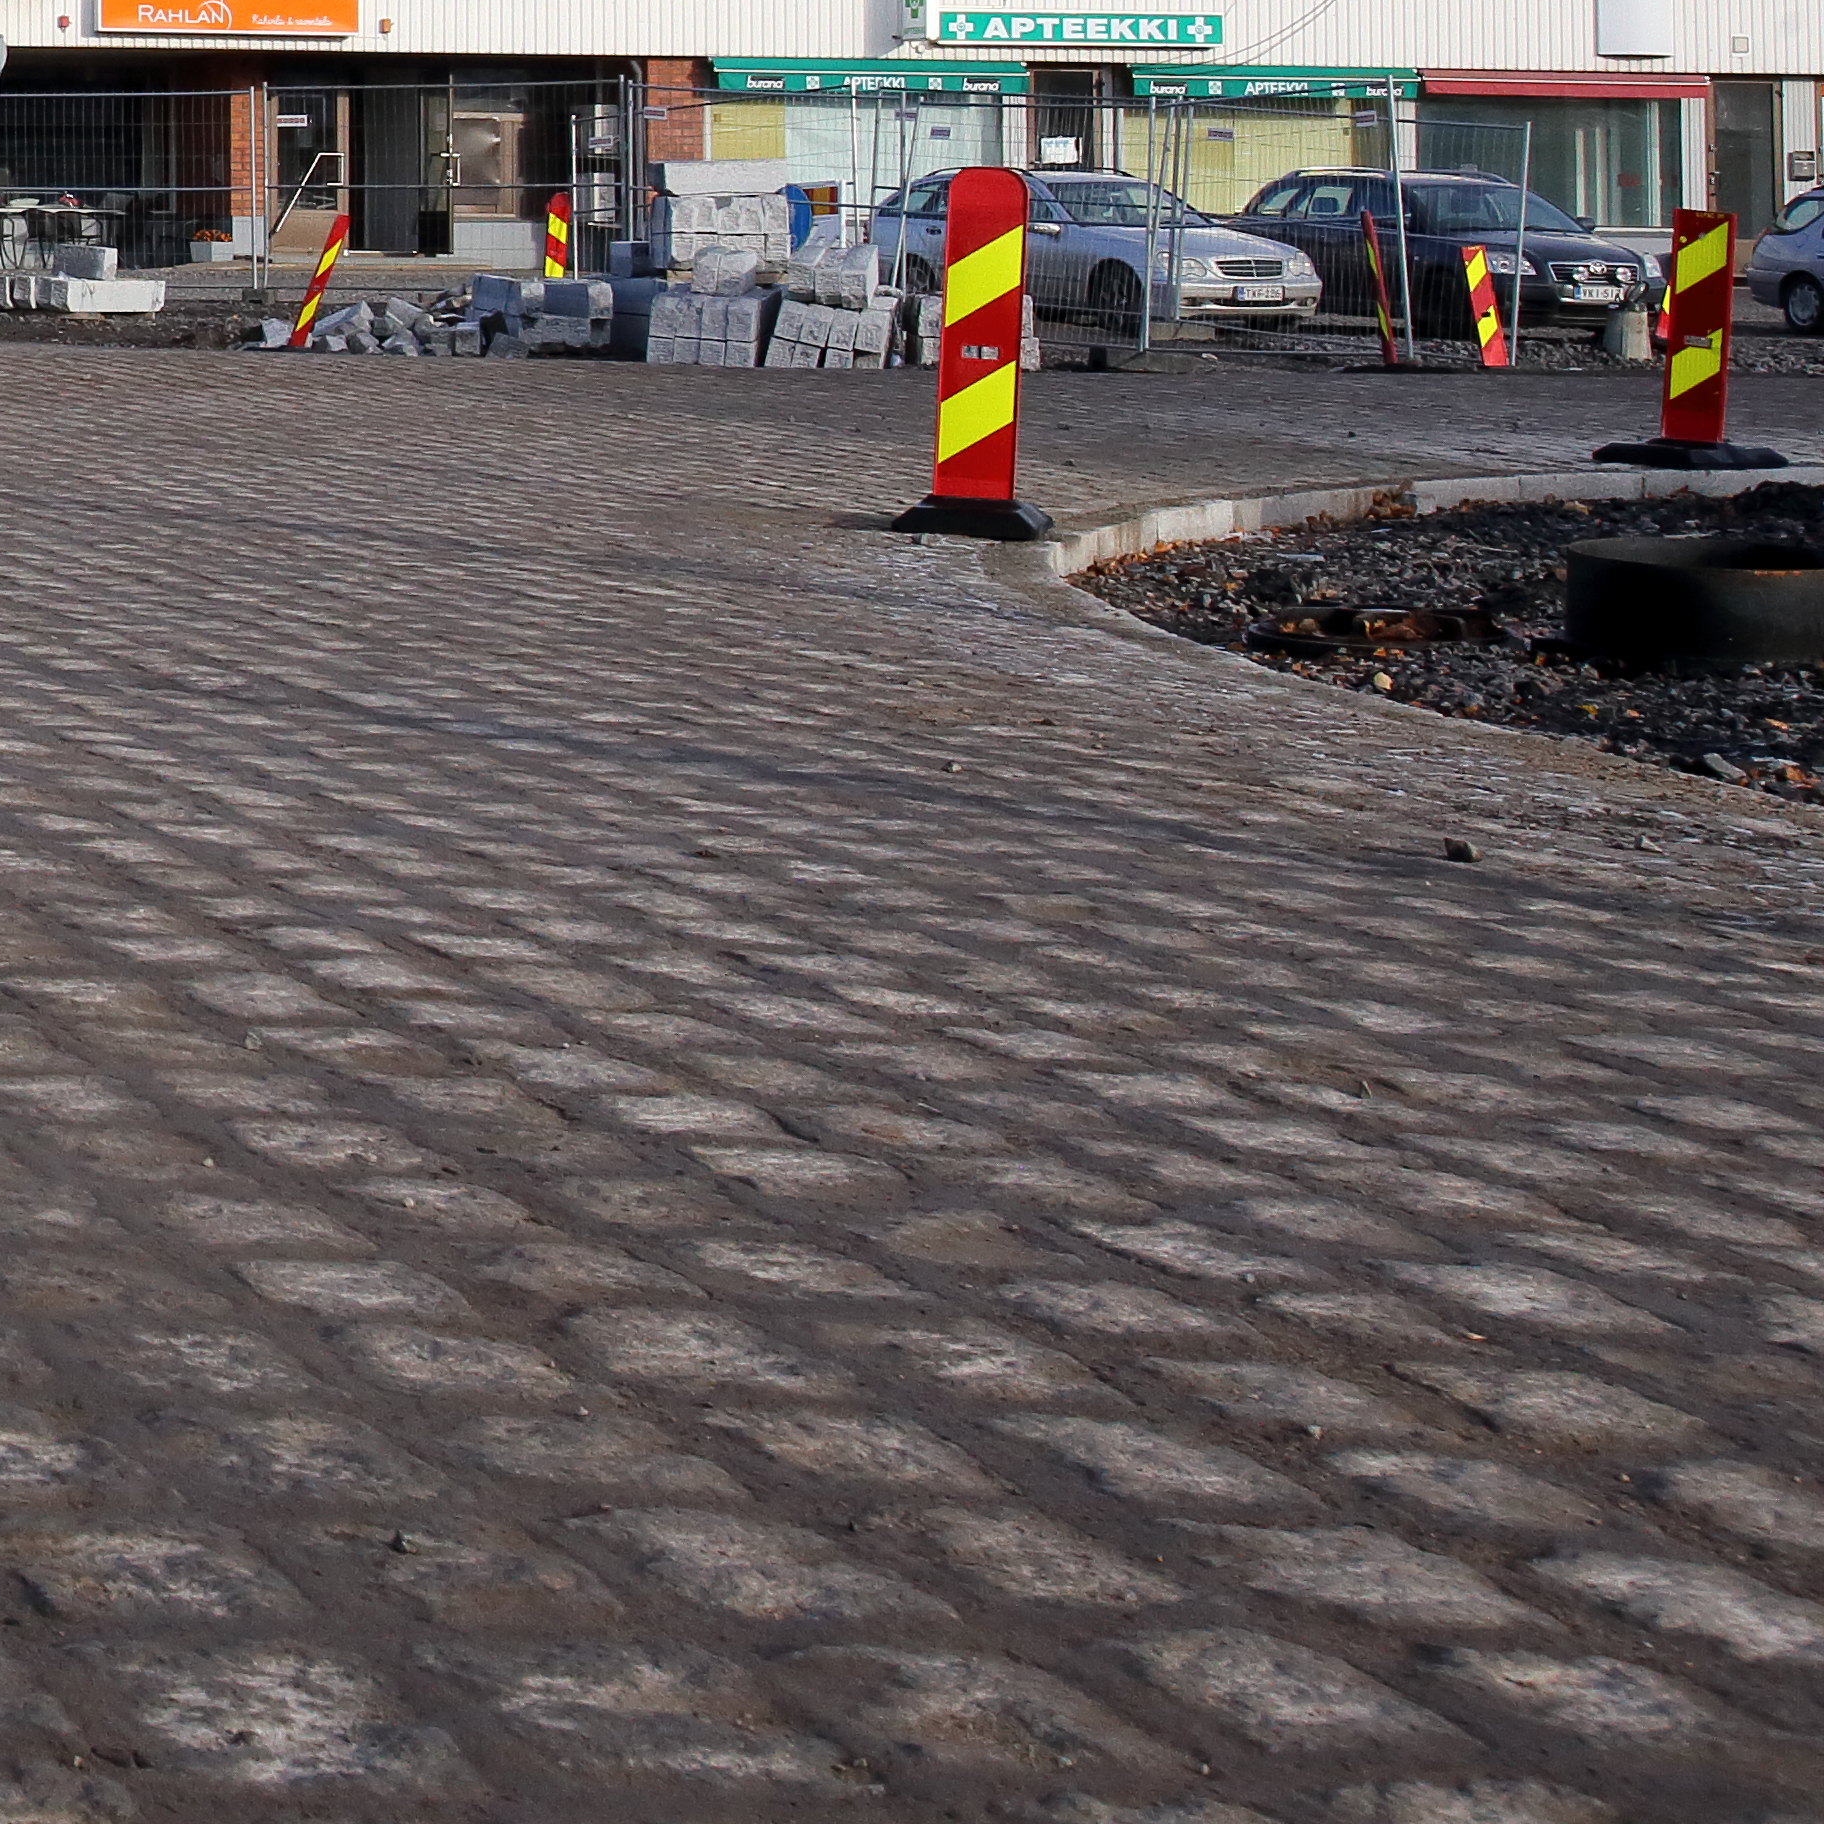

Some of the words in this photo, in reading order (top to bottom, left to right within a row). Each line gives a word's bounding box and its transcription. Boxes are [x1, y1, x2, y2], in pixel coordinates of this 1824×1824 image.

[982, 17, 1178, 41] APTEEKKI
[747, 75, 784, 89] burana
[962, 77, 1000, 91] burana
[1149, 80, 1187, 94] burana
